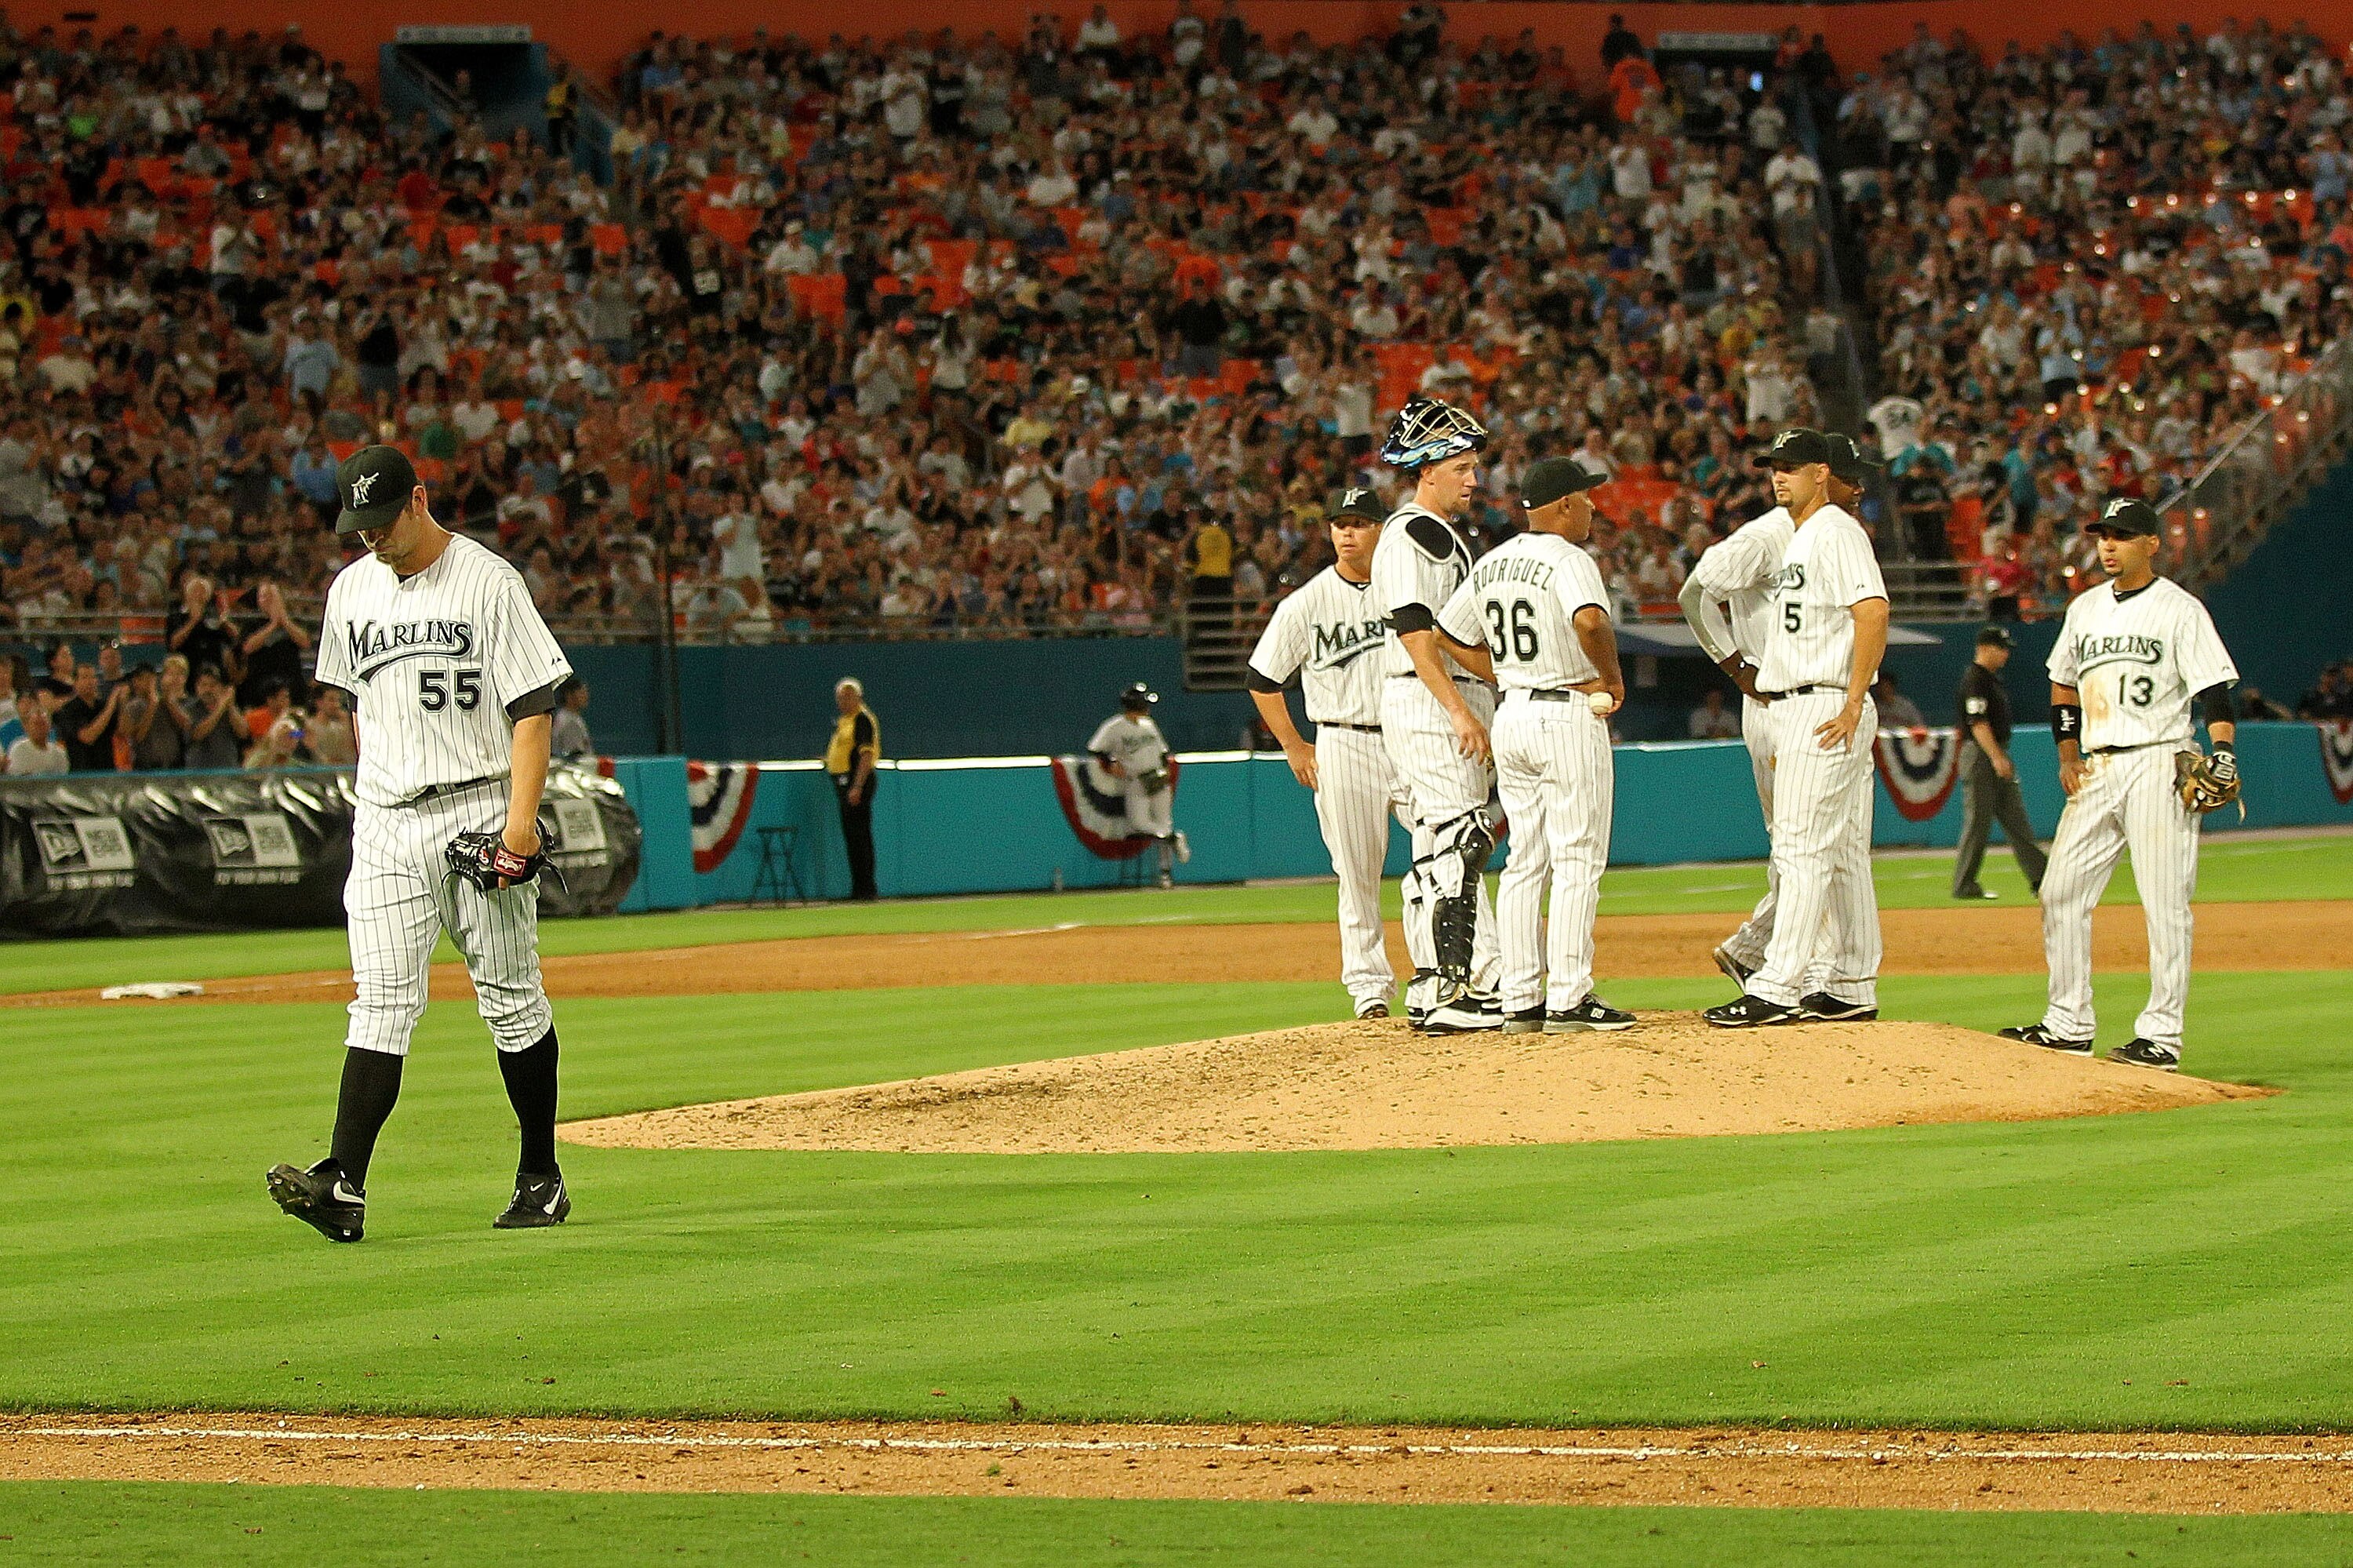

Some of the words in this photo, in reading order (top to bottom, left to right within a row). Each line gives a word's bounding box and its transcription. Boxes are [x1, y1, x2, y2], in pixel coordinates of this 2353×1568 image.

[1472, 557, 1555, 595] RODRIGUEZ
[1486, 598, 1541, 664] 36
[1784, 601, 1802, 635] 5
[347, 619, 472, 676] MARLINS
[418, 668, 482, 713] 55
[2118, 672, 2154, 708] 13
